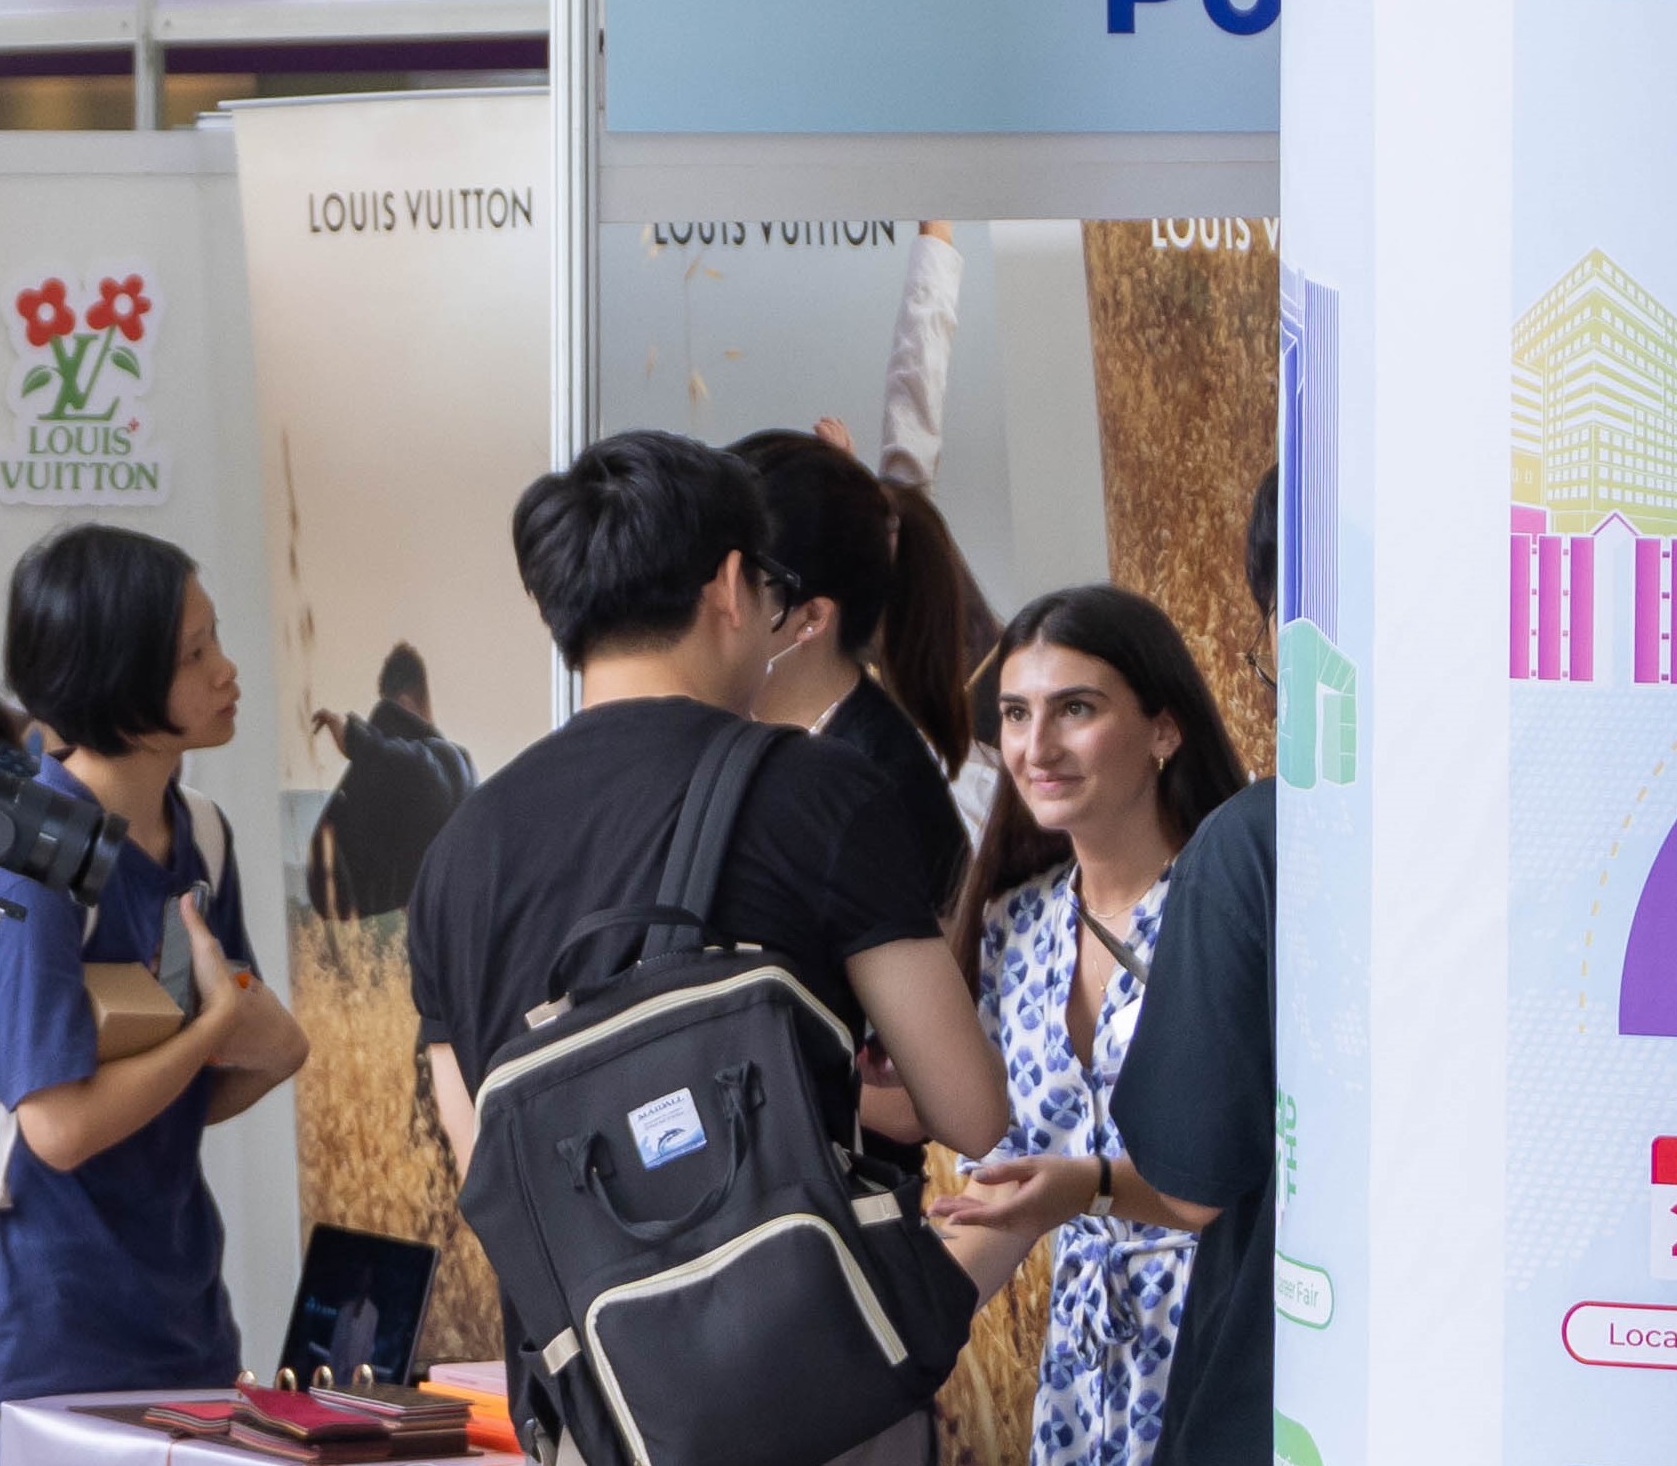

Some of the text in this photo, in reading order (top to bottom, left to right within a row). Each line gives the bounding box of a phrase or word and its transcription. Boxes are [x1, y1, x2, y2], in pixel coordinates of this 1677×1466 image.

[309, 188, 533, 234] LOUIS VUITTON
[29, 424, 133, 455] LOUIS
[0, 462, 158, 492] VUITTON
